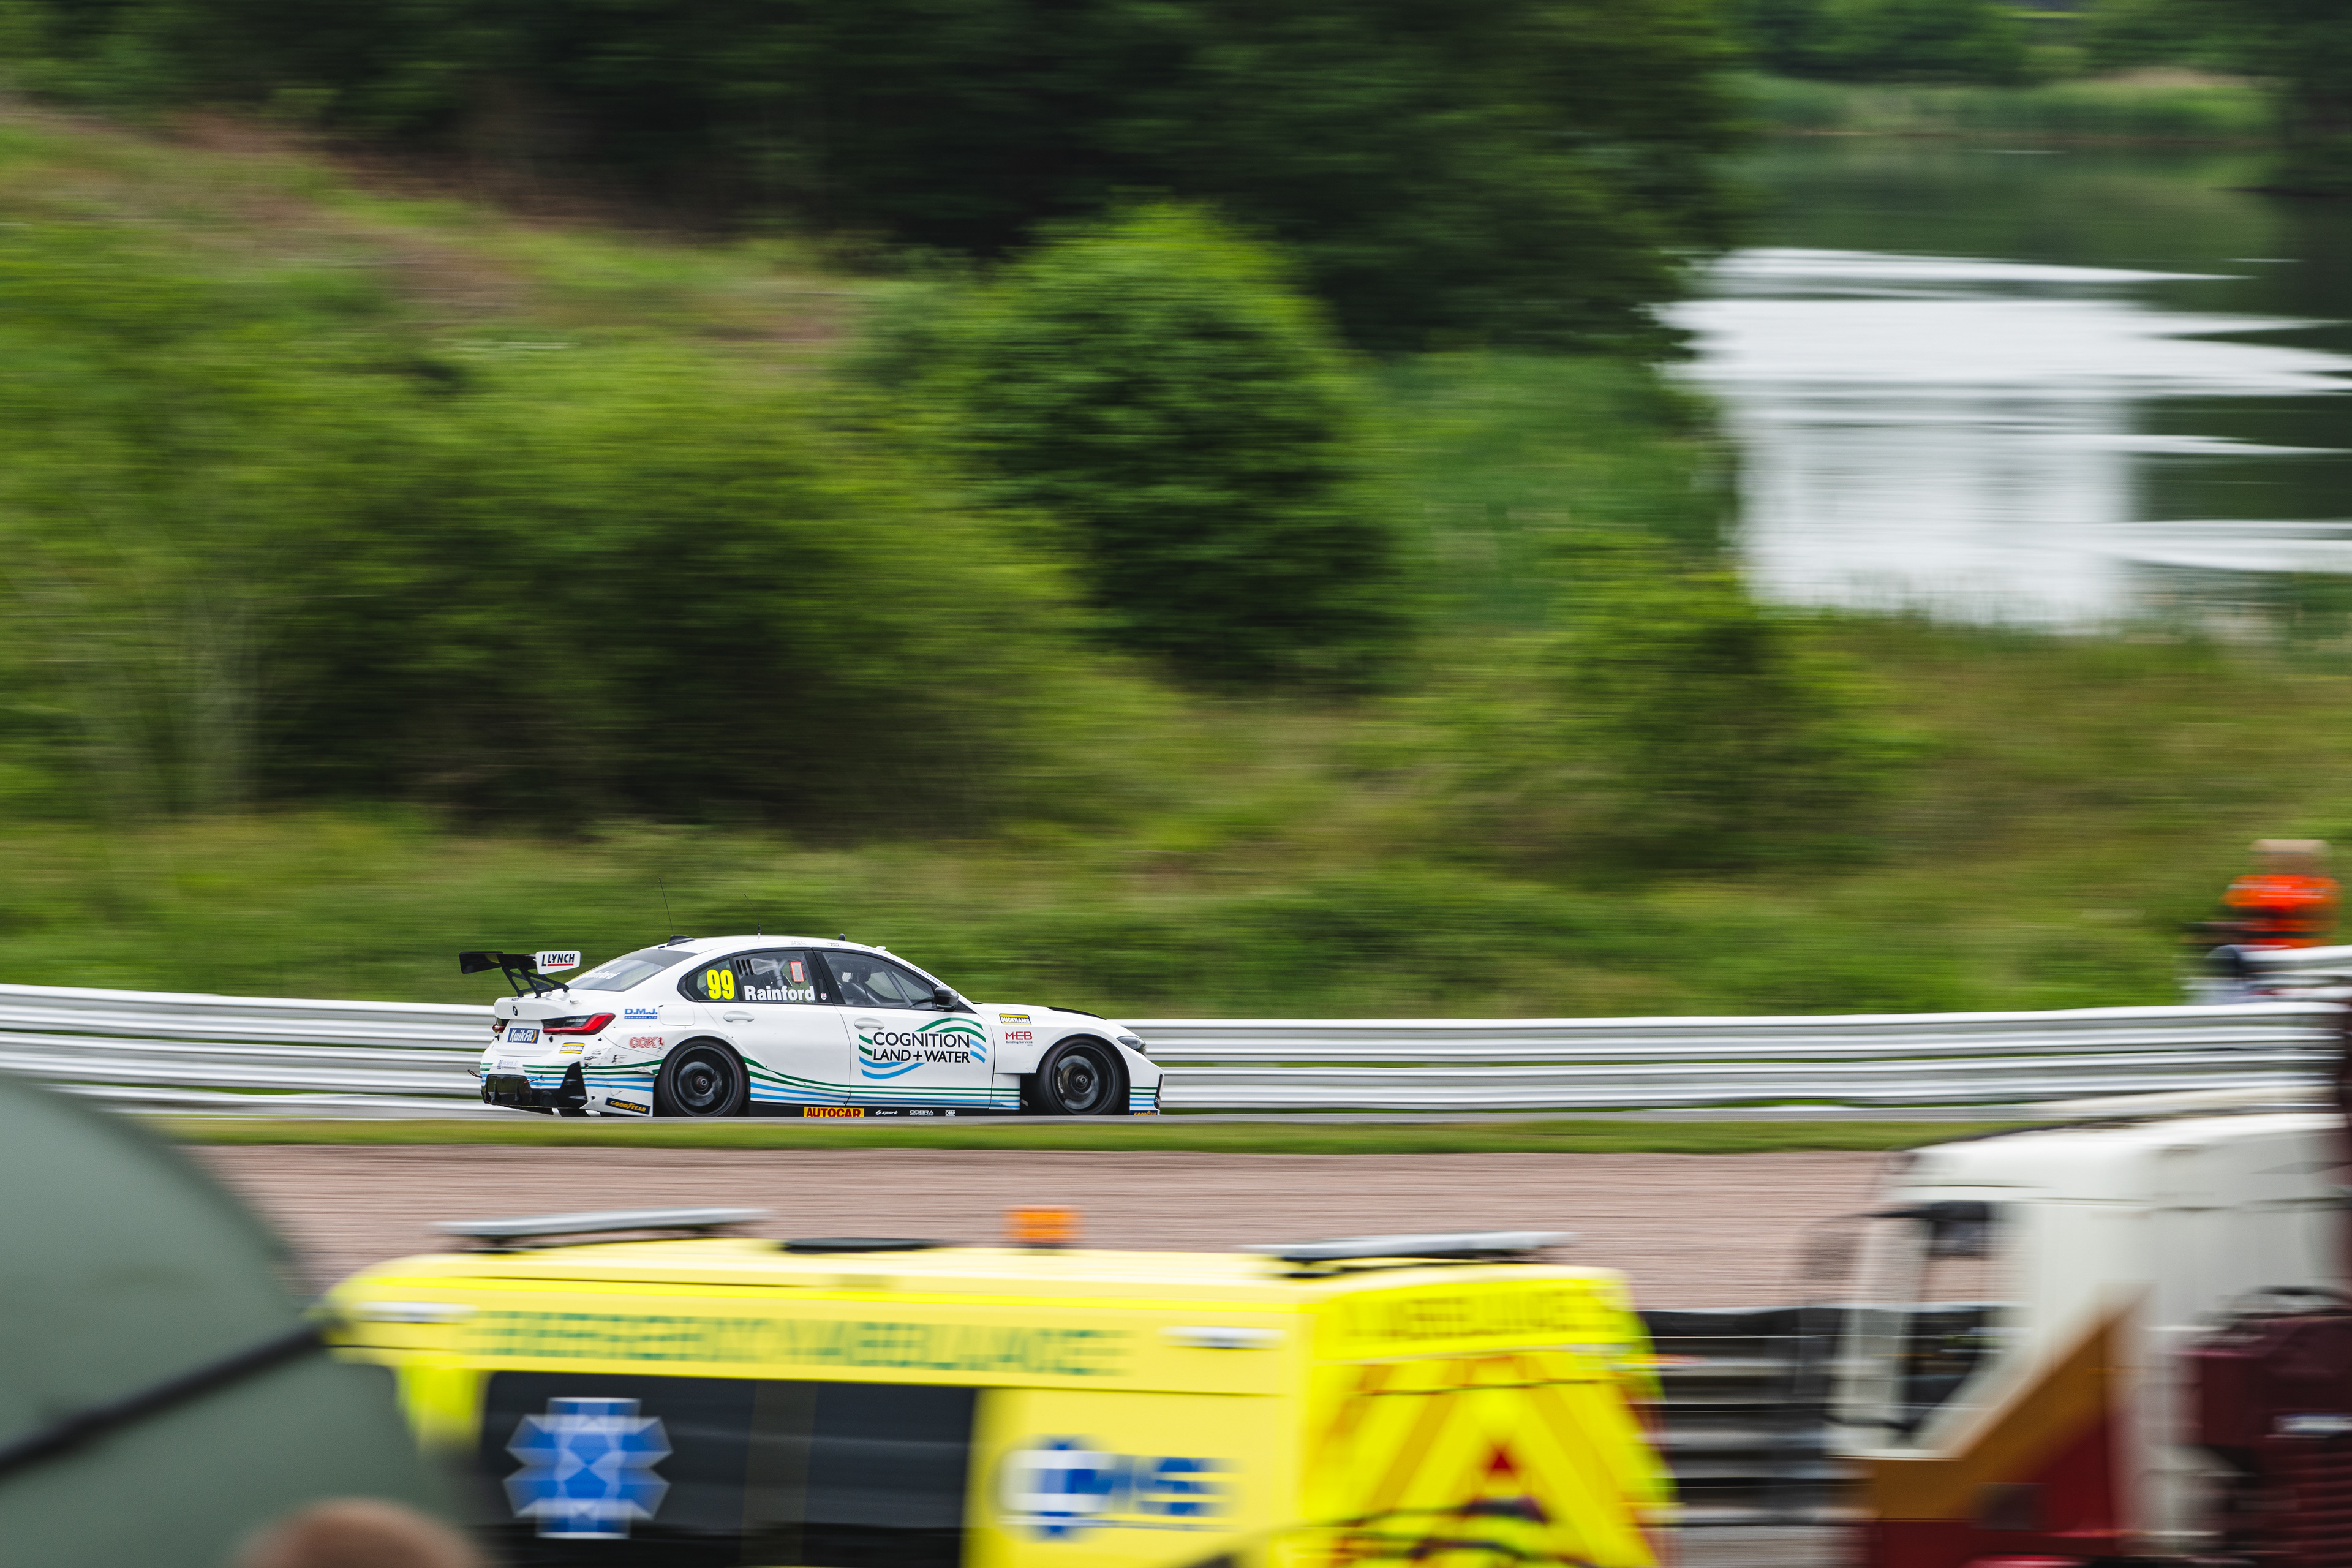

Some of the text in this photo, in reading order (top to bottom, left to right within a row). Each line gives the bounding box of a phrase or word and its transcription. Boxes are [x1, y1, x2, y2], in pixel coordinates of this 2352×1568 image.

[706, 969, 735, 1000] 99
[744, 985, 815, 1001] Rainford
[629, 1036, 659, 1049] CCK
[873, 1031, 970, 1049] COGNITION
[1005, 1031, 1033, 1040] MEB
[873, 1049, 911, 1061] LAND
[924, 1050, 971, 1064] WATER
[610, 1101, 647, 1112] GOODYEAR
[806, 1108, 861, 1117] AUTOCAR
